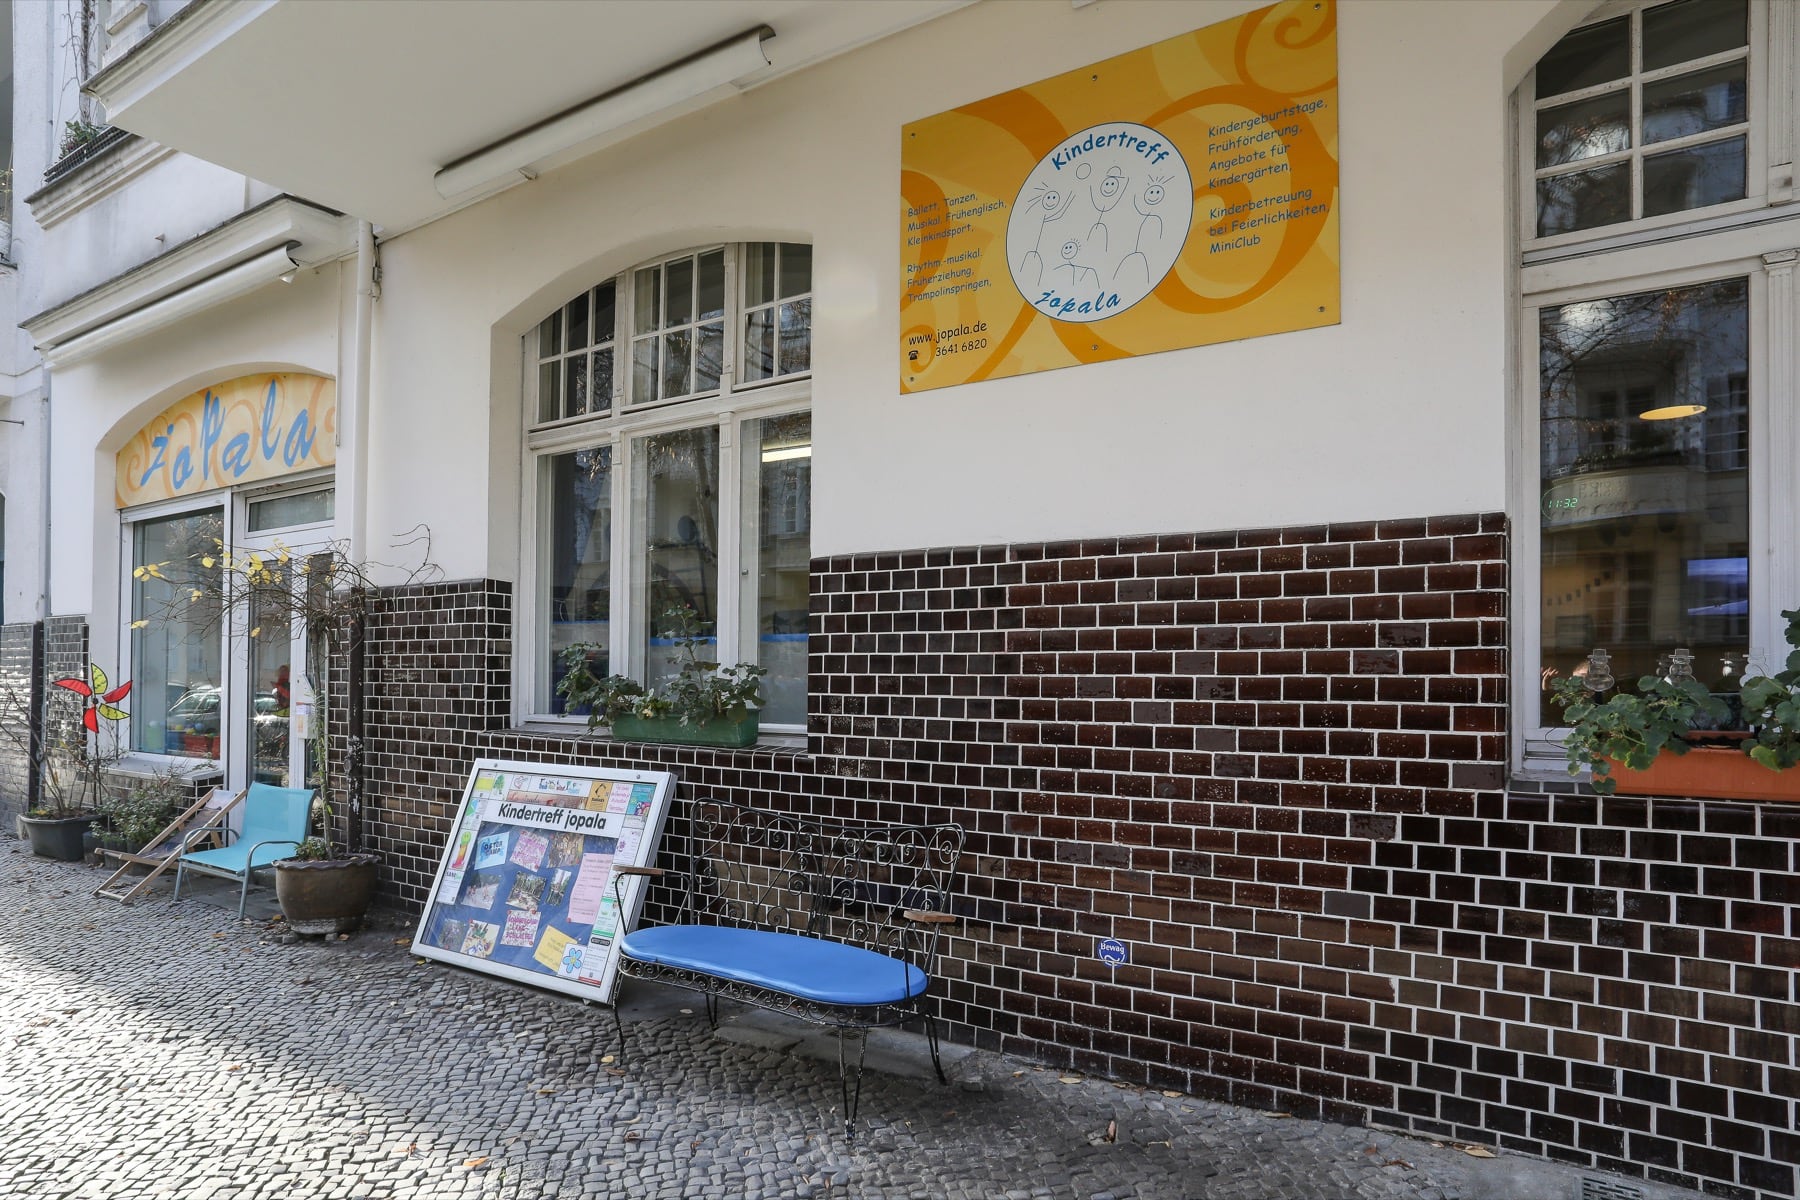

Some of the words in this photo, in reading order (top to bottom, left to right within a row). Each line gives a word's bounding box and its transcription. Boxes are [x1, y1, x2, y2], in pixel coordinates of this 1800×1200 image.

[1208, 99, 1328, 138] Kindergeburtstage,
[1051, 131, 1170, 171] Kindertreff
[1208, 150, 1266, 172] Angebote
[1270, 143, 1291, 157] für
[1208, 162, 1292, 189] Kindergärten,
[944, 193, 978, 207] Tanzen,
[1209, 189, 1312, 219] Kinderbetreuung
[1209, 225, 1227, 236] bei
[1231, 203, 1330, 232] Feierlichkeiten,
[1209, 234, 1261, 254] MiniClub
[908, 278, 992, 303] Trampolinspringen,
[1034, 289, 1122, 317] jopala
[908, 320, 988, 346] www.jopala.de
[935, 343, 958, 357] 3641
[961, 338, 987, 352] 6820
[140, 378, 317, 490] jopala
[1548, 497, 1578, 509] 11:32
[498, 803, 564, 826] Kindertreff
[564, 809, 607, 831] jopala
[1100, 942, 1125, 955] Bewag
